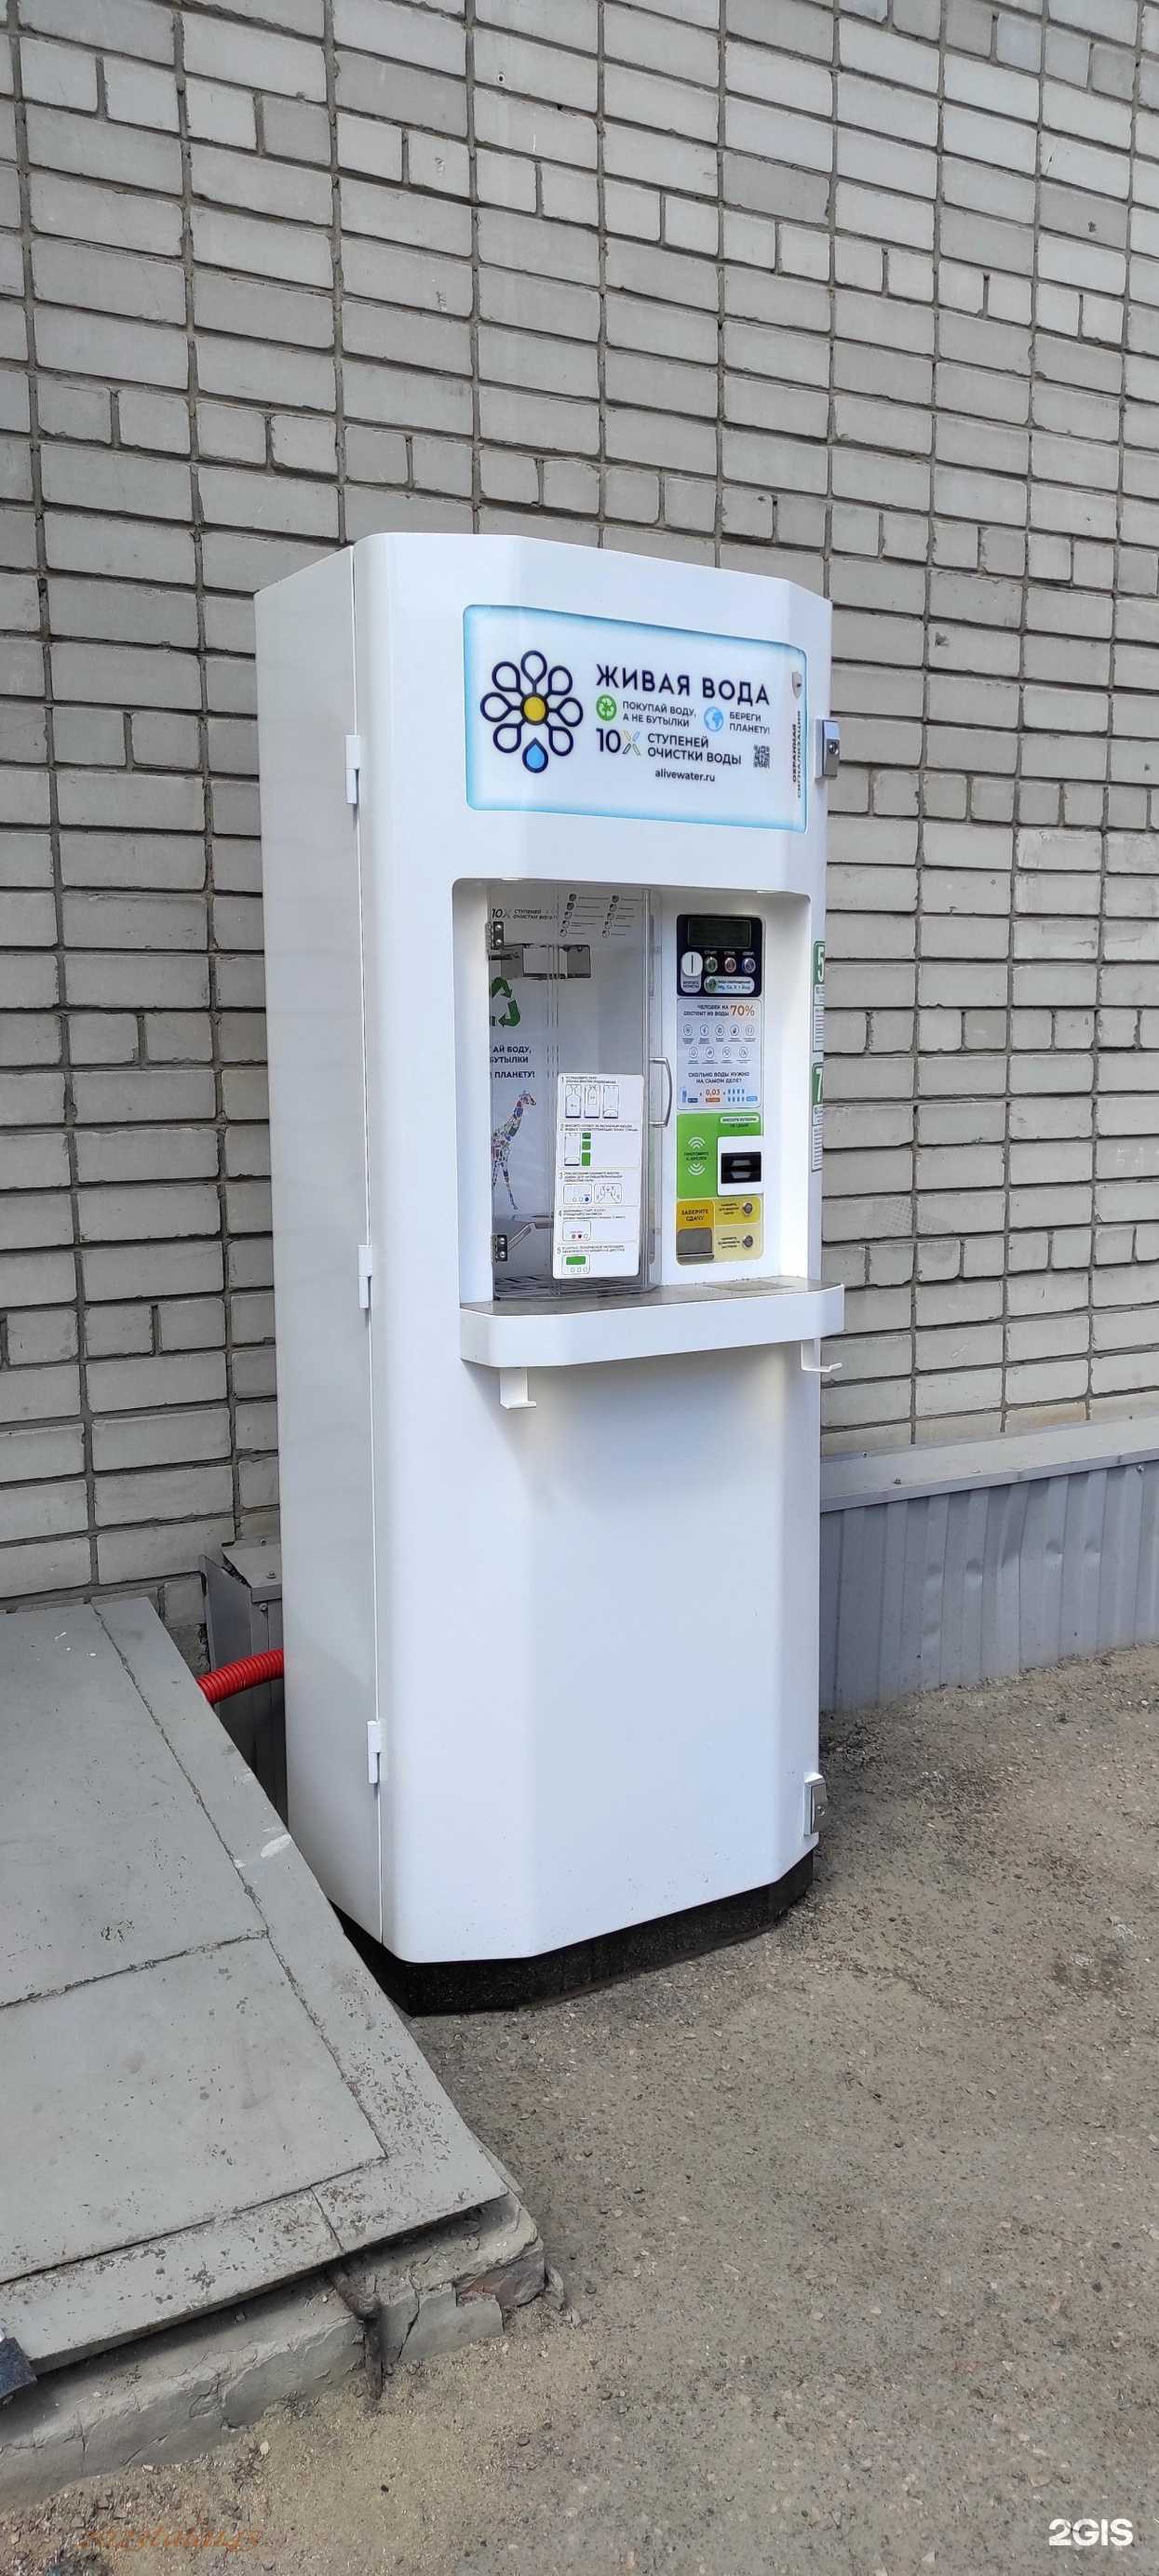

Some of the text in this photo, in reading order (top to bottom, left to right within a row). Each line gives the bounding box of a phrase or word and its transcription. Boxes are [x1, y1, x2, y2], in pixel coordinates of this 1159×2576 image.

[596, 664, 771, 706] ЖИВАЯ ВОДА
[622, 701, 697, 718] ПОКУПАЙ ВОДУ,
[729, 711, 761, 722] БЕРЕГИ
[632, 715, 643, 723] НЕ
[646, 715, 690, 728] БУТЫЛКИ
[729, 722, 771, 735] ПЛАНЕТУ!
[647, 732, 709, 749] СТУПЕНЕЙ
[647, 746, 742, 766] ОЧИСТКИ ВОДЫ
[654, 768, 716, 783] alivewater.ru
[730, 1005, 755, 1016] 70%
